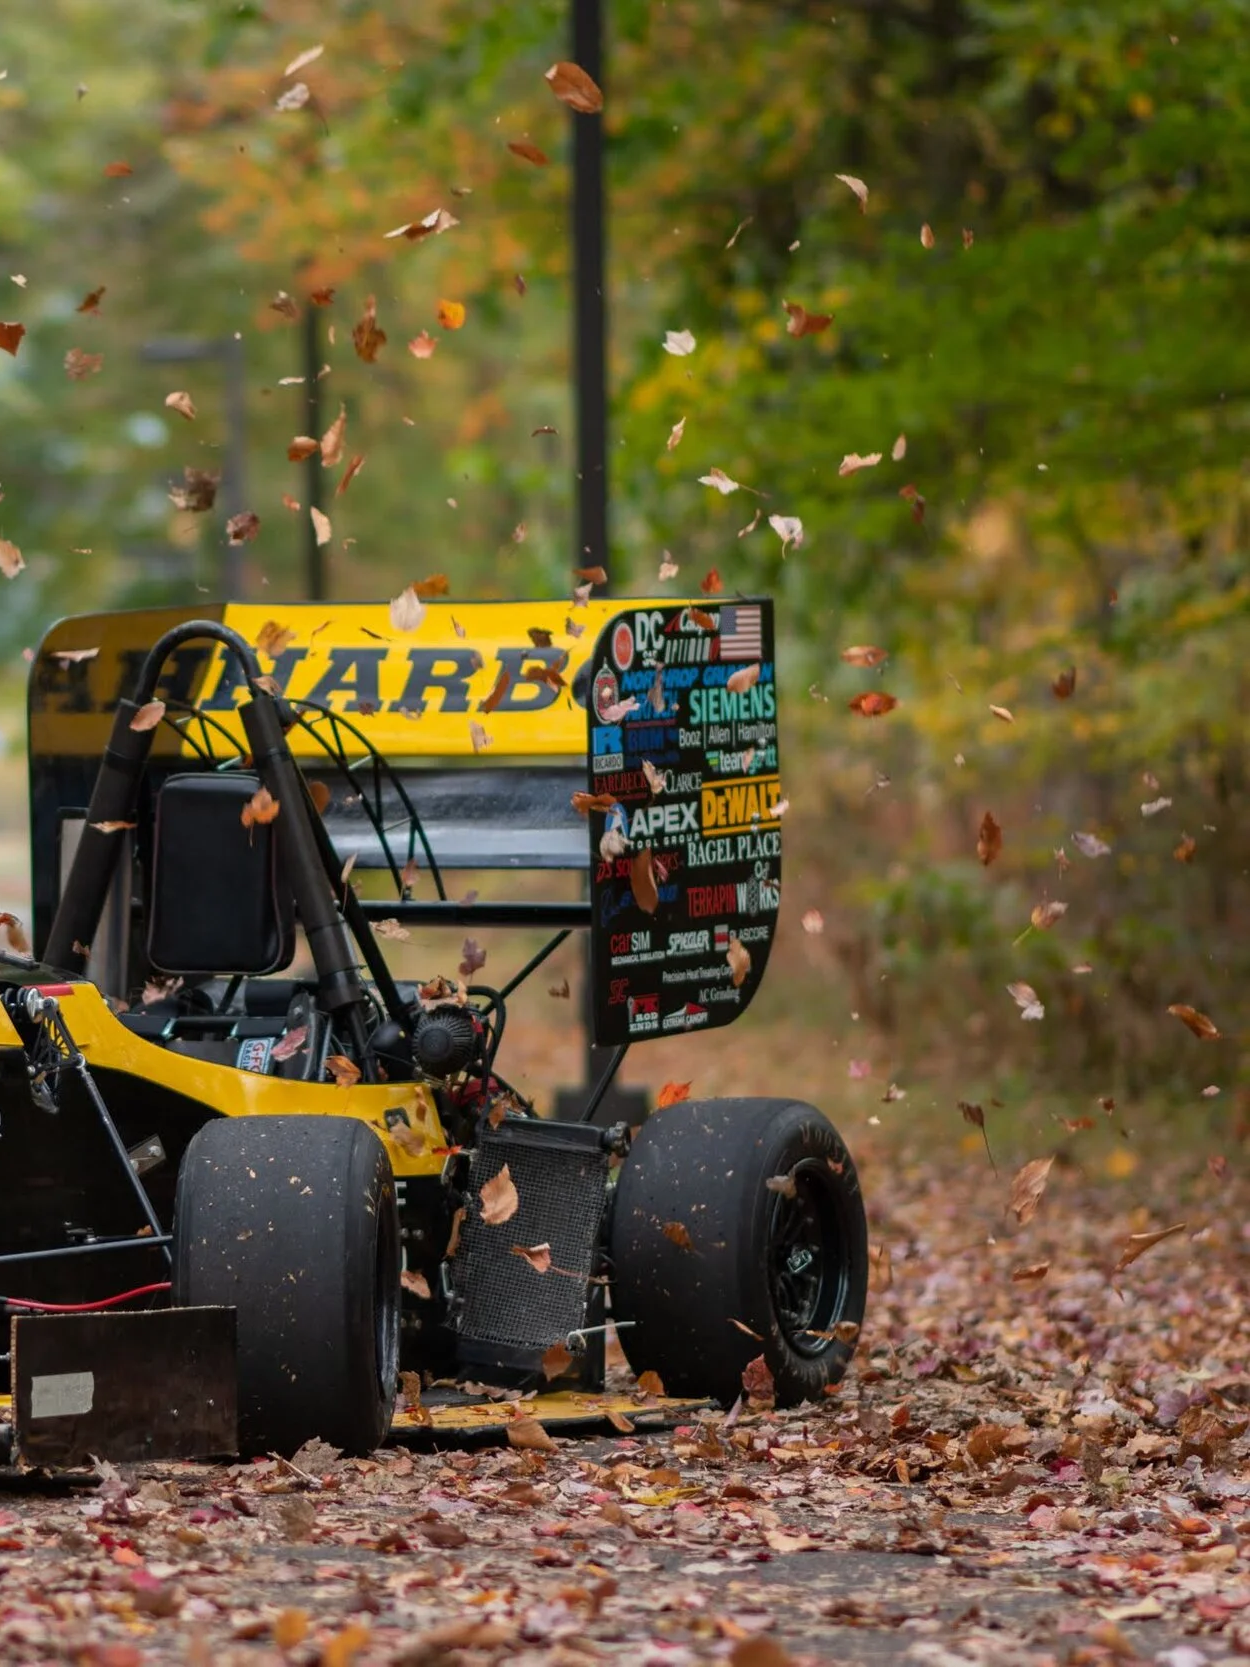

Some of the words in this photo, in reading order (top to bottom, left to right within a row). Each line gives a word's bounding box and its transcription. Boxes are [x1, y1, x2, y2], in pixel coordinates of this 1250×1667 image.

[200, 647, 589, 713] HARB
[690, 684, 775, 725] SIEMENS
[679, 728, 701, 748] Booz
[708, 724, 730, 744] Allen
[738, 721, 775, 741] Hamilton
[630, 801, 700, 838] APEX
[629, 839, 658, 850] TOOL
[663, 832, 700, 847] GROUP
[687, 838, 735, 867] BAGEL
[737, 831, 782, 859] PLACE
